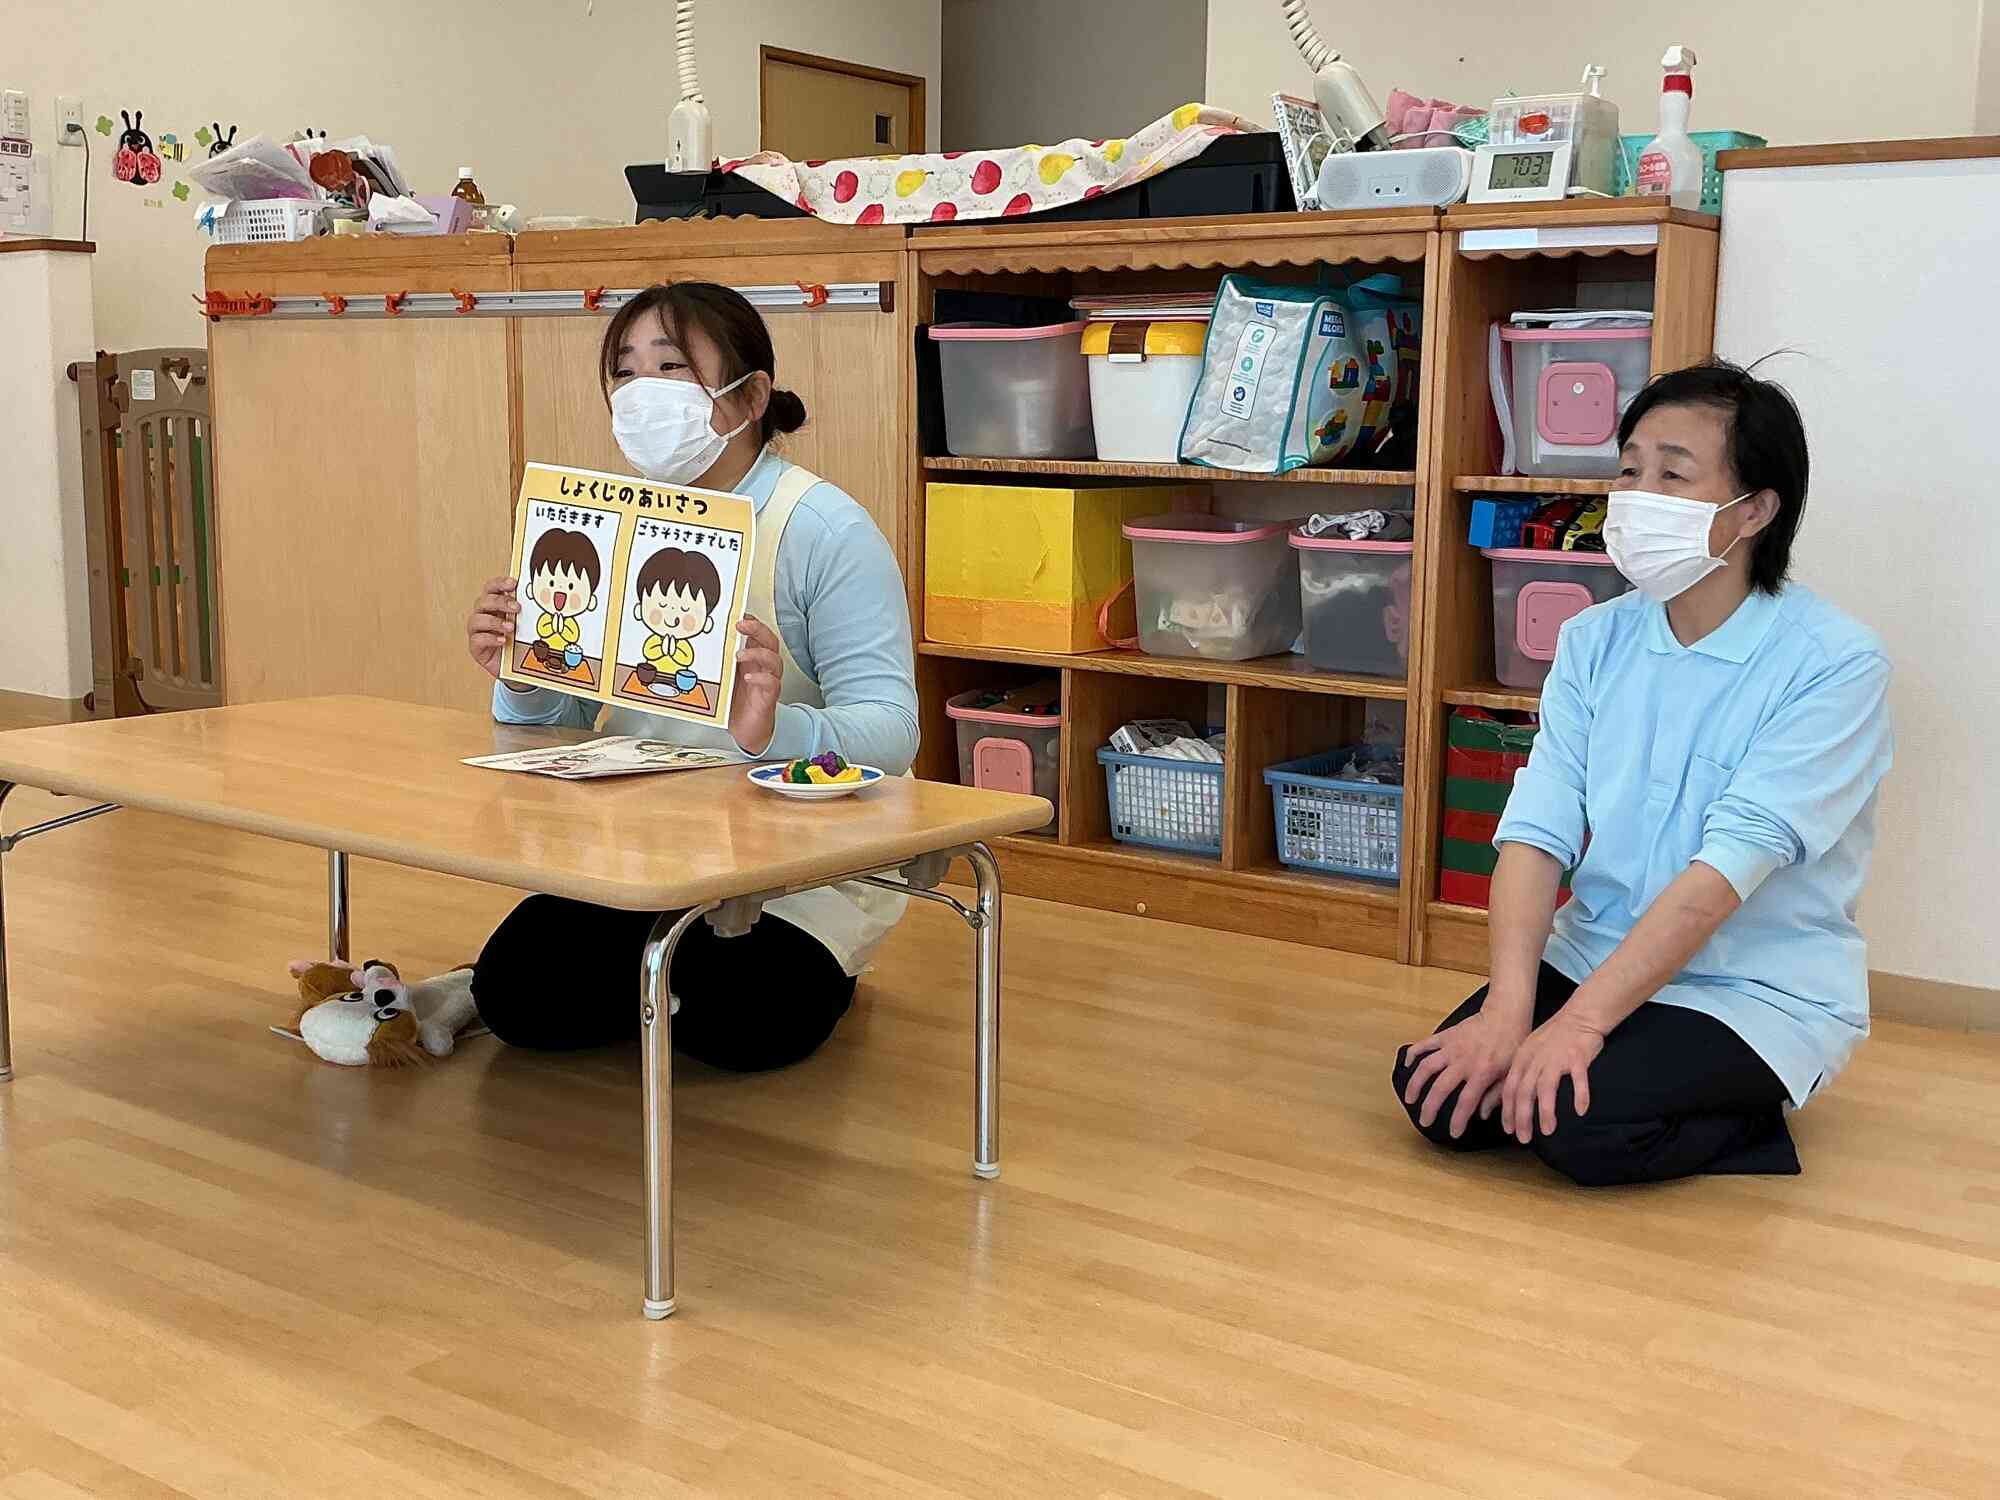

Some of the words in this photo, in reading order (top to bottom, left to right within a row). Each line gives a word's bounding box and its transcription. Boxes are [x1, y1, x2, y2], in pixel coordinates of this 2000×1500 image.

[560, 476, 708, 515] しょくじのあいさつ
[535, 505, 605, 529] いただきます
[637, 520, 739, 551] ごちそうさまでした
